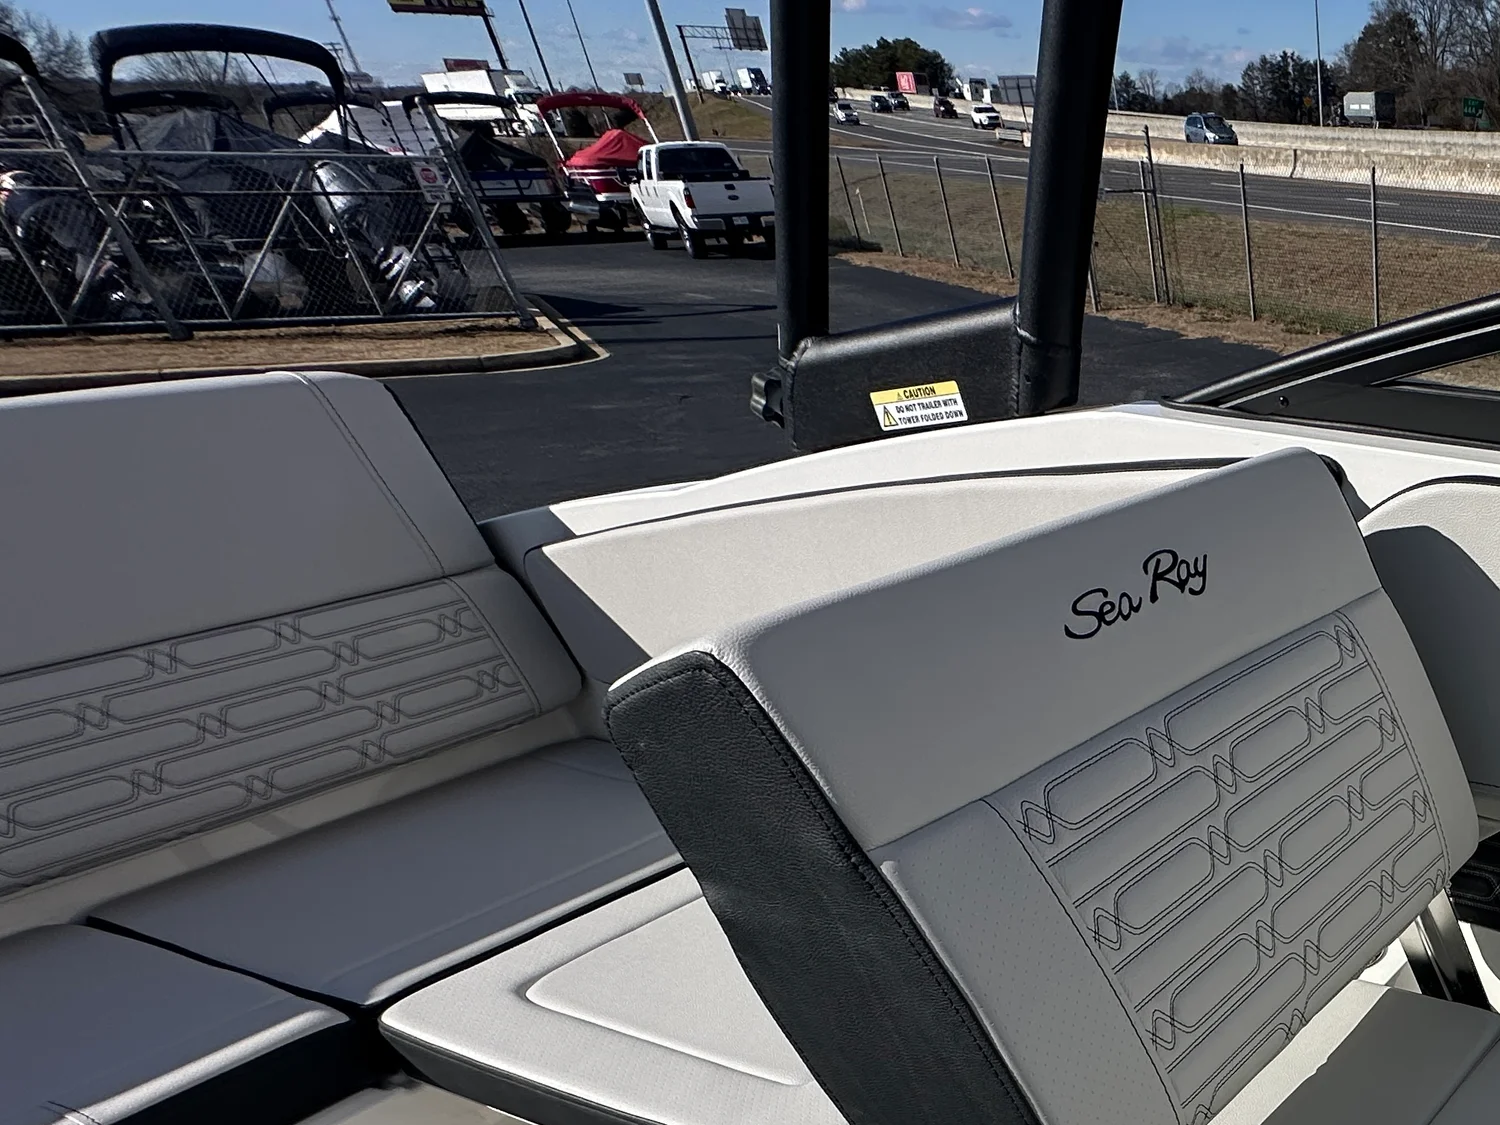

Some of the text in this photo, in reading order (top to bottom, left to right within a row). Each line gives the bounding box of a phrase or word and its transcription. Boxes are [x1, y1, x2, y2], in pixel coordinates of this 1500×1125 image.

[903, 385, 937, 399] CAUTION
[895, 398, 959, 414] DO NOT TRAILER WITH
[898, 410, 964, 425] TOWER FOLDED DOWN
[1064, 549, 1208, 640] Sea Ray
